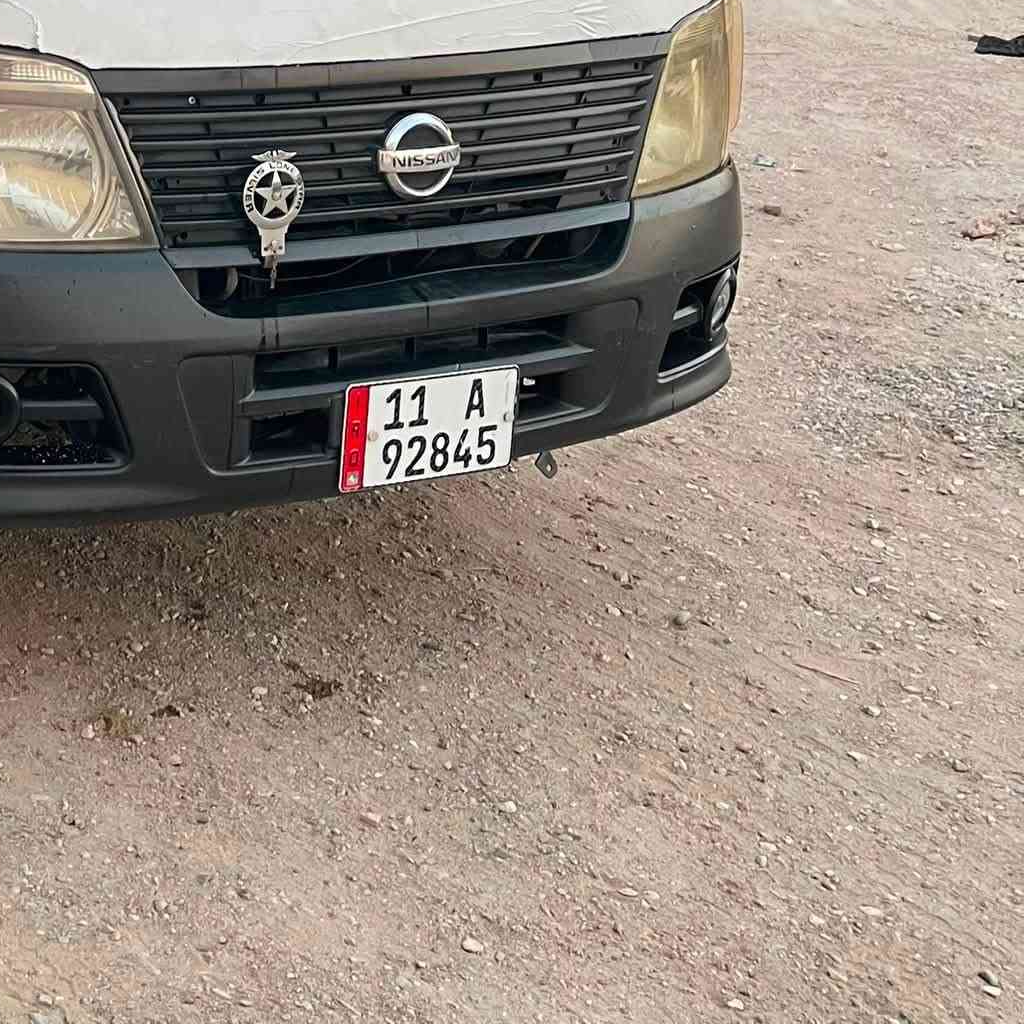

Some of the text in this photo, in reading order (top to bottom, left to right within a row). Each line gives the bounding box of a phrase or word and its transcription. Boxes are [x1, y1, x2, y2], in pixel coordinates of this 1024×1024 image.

[392, 149, 459, 169] NISSAN
[384, 378, 485, 431] 11 A
[382, 425, 498, 480] 92845
